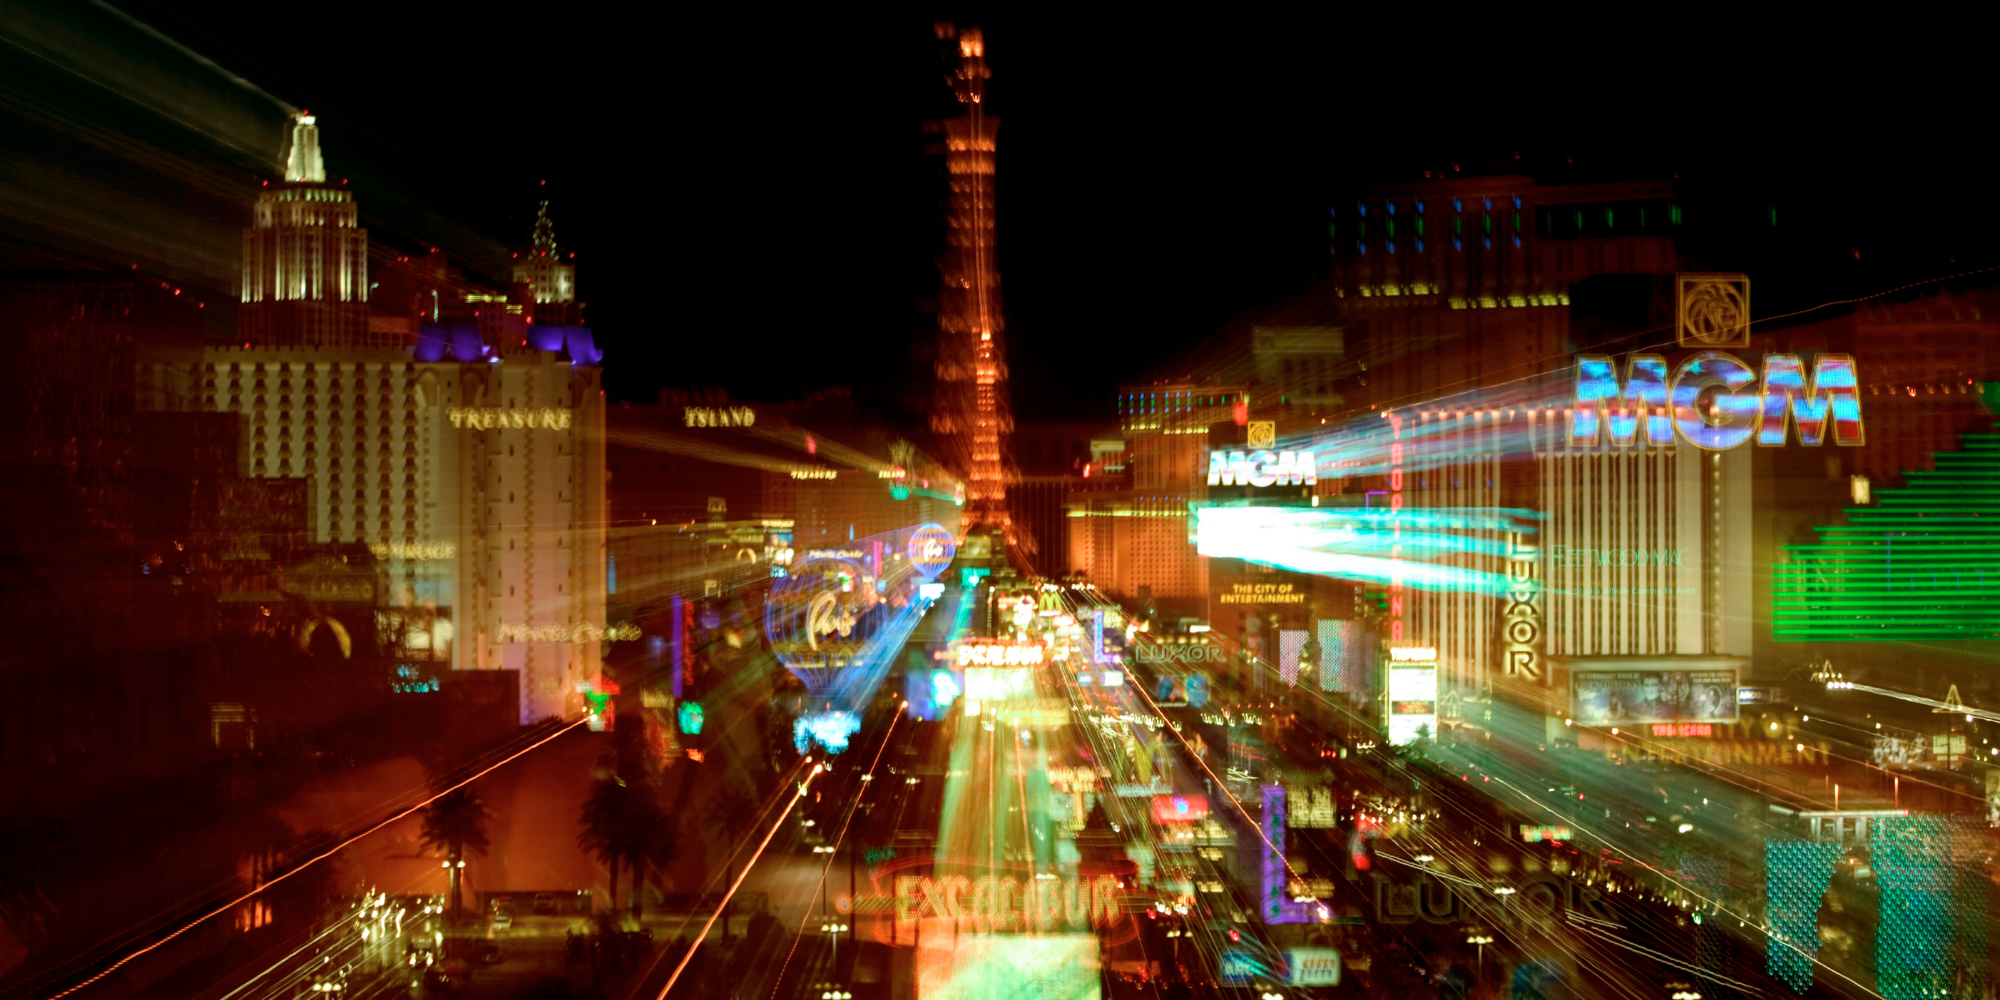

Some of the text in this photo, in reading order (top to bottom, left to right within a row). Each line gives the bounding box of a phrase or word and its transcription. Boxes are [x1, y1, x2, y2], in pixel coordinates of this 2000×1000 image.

[1570, 351, 1865, 450] MGM
[448, 407, 572, 431] TREASURE
[683, 406, 755, 428] ISLAND
[790, 470, 837, 480] TREASURE
[1207, 450, 1318, 487] MGM
[1551, 544, 1693, 571] FLEETWOOD MAC
[1220, 594, 1305, 604] ENTERTAINMENT
[1233, 584, 1293, 593] THE CITY OF
[1506, 531, 1541, 679] LUXOR
[1136, 645, 1227, 664] LUXOR
[896, 875, 1122, 928] EXCALIBUR
